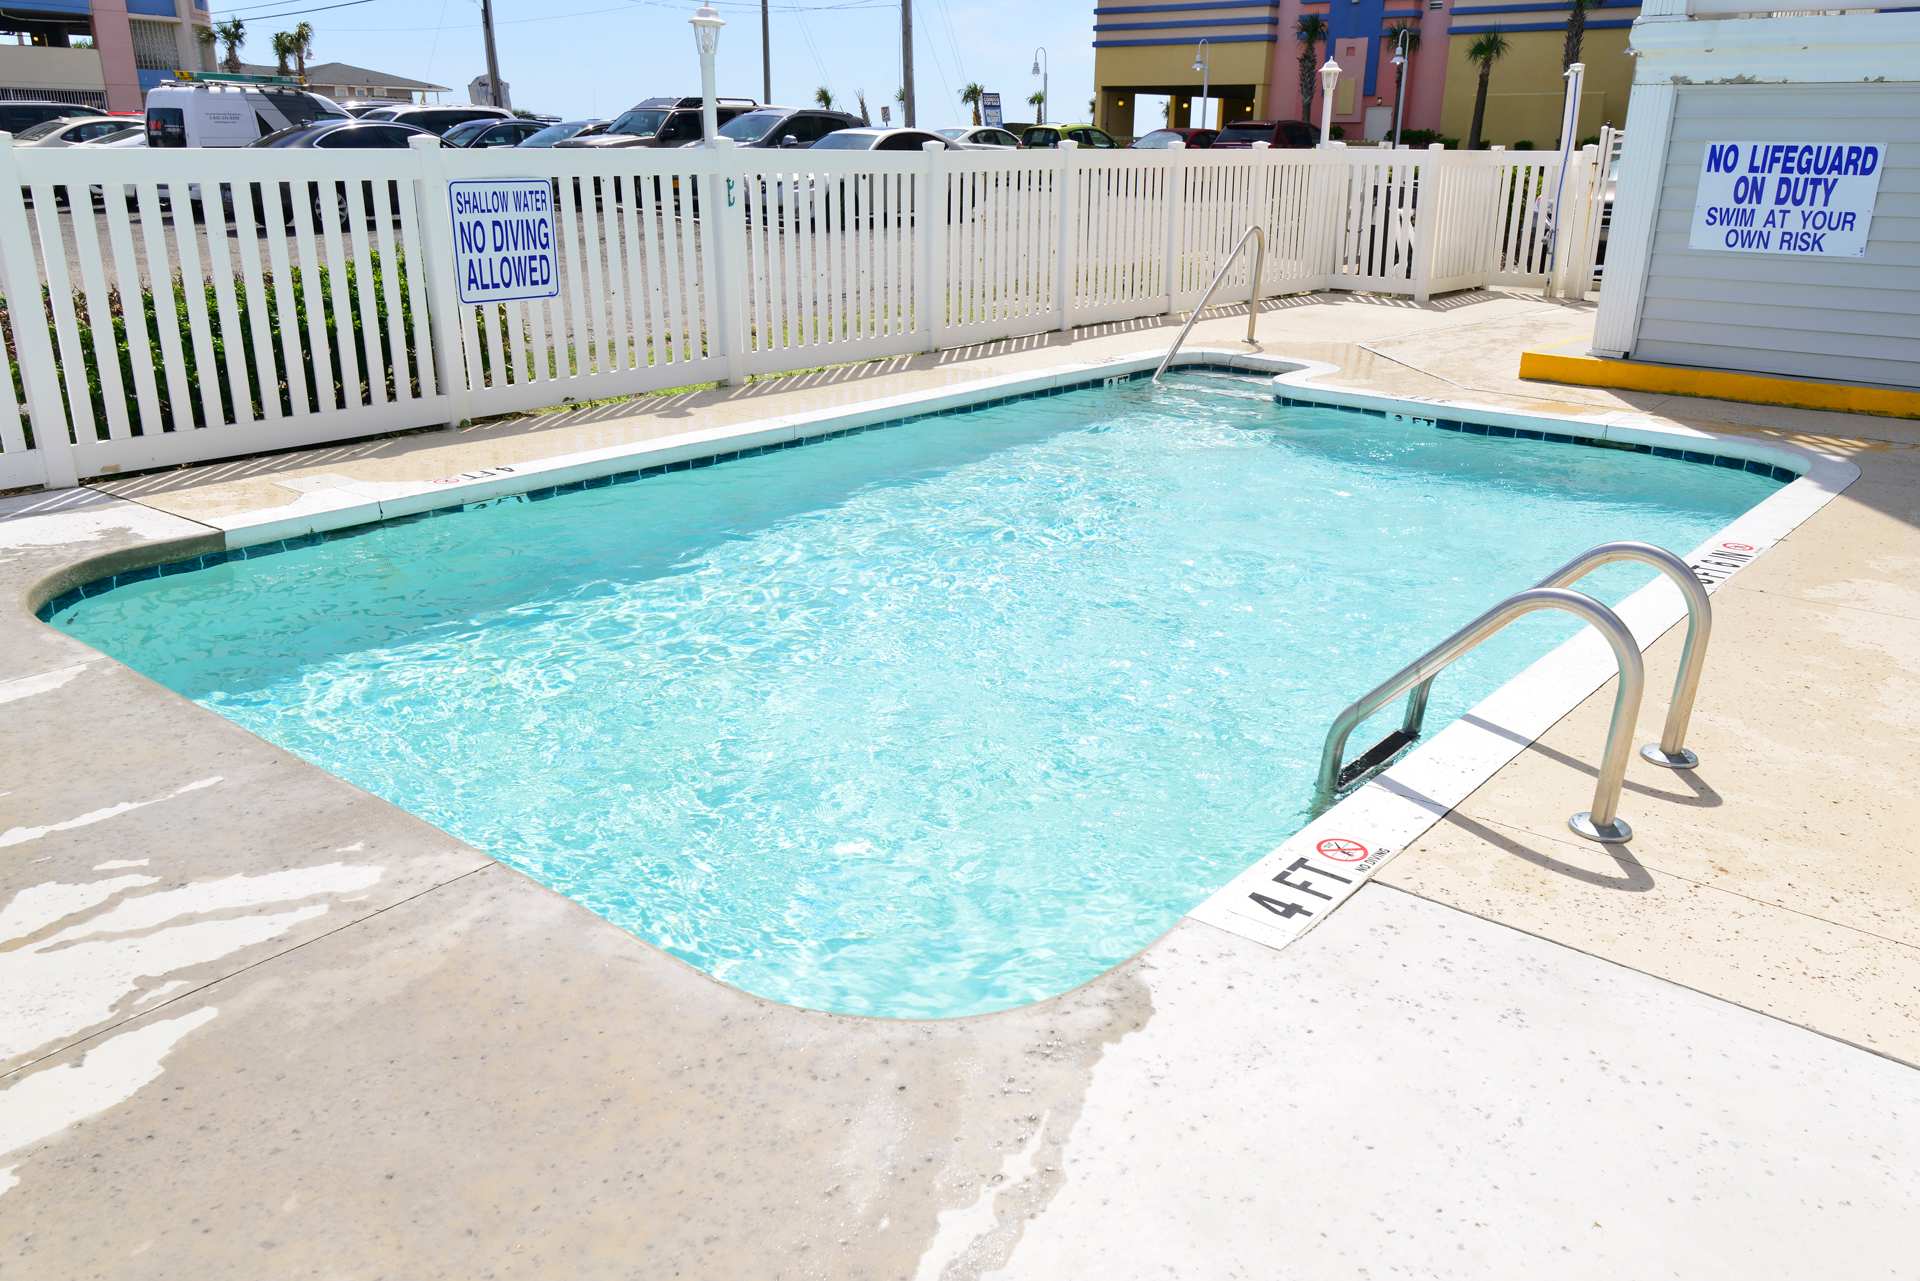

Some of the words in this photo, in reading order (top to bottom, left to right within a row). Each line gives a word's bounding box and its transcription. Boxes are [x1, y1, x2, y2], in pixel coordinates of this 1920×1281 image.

[1706, 144, 1739, 173] NO
[1748, 145, 1879, 176] LIFEGUARD
[456, 191, 509, 214] SHALLOW
[513, 190, 548, 212] WATER
[1733, 175, 1766, 205] ON
[1774, 177, 1839, 207] DUTY
[1705, 206, 1756, 227] SWIM
[1763, 209, 1791, 229] AT
[1800, 210, 1857, 231] YOUR
[459, 220, 486, 254] NO
[492, 218, 550, 252] DIVING
[1724, 229, 1771, 250] OWN
[1779, 231, 1827, 252] RISK
[467, 254, 551, 291] ALLOWED
[1271, 857, 1353, 901] FT
[1355, 863, 1371, 873] NO
[1248, 892, 1314, 919] 4
